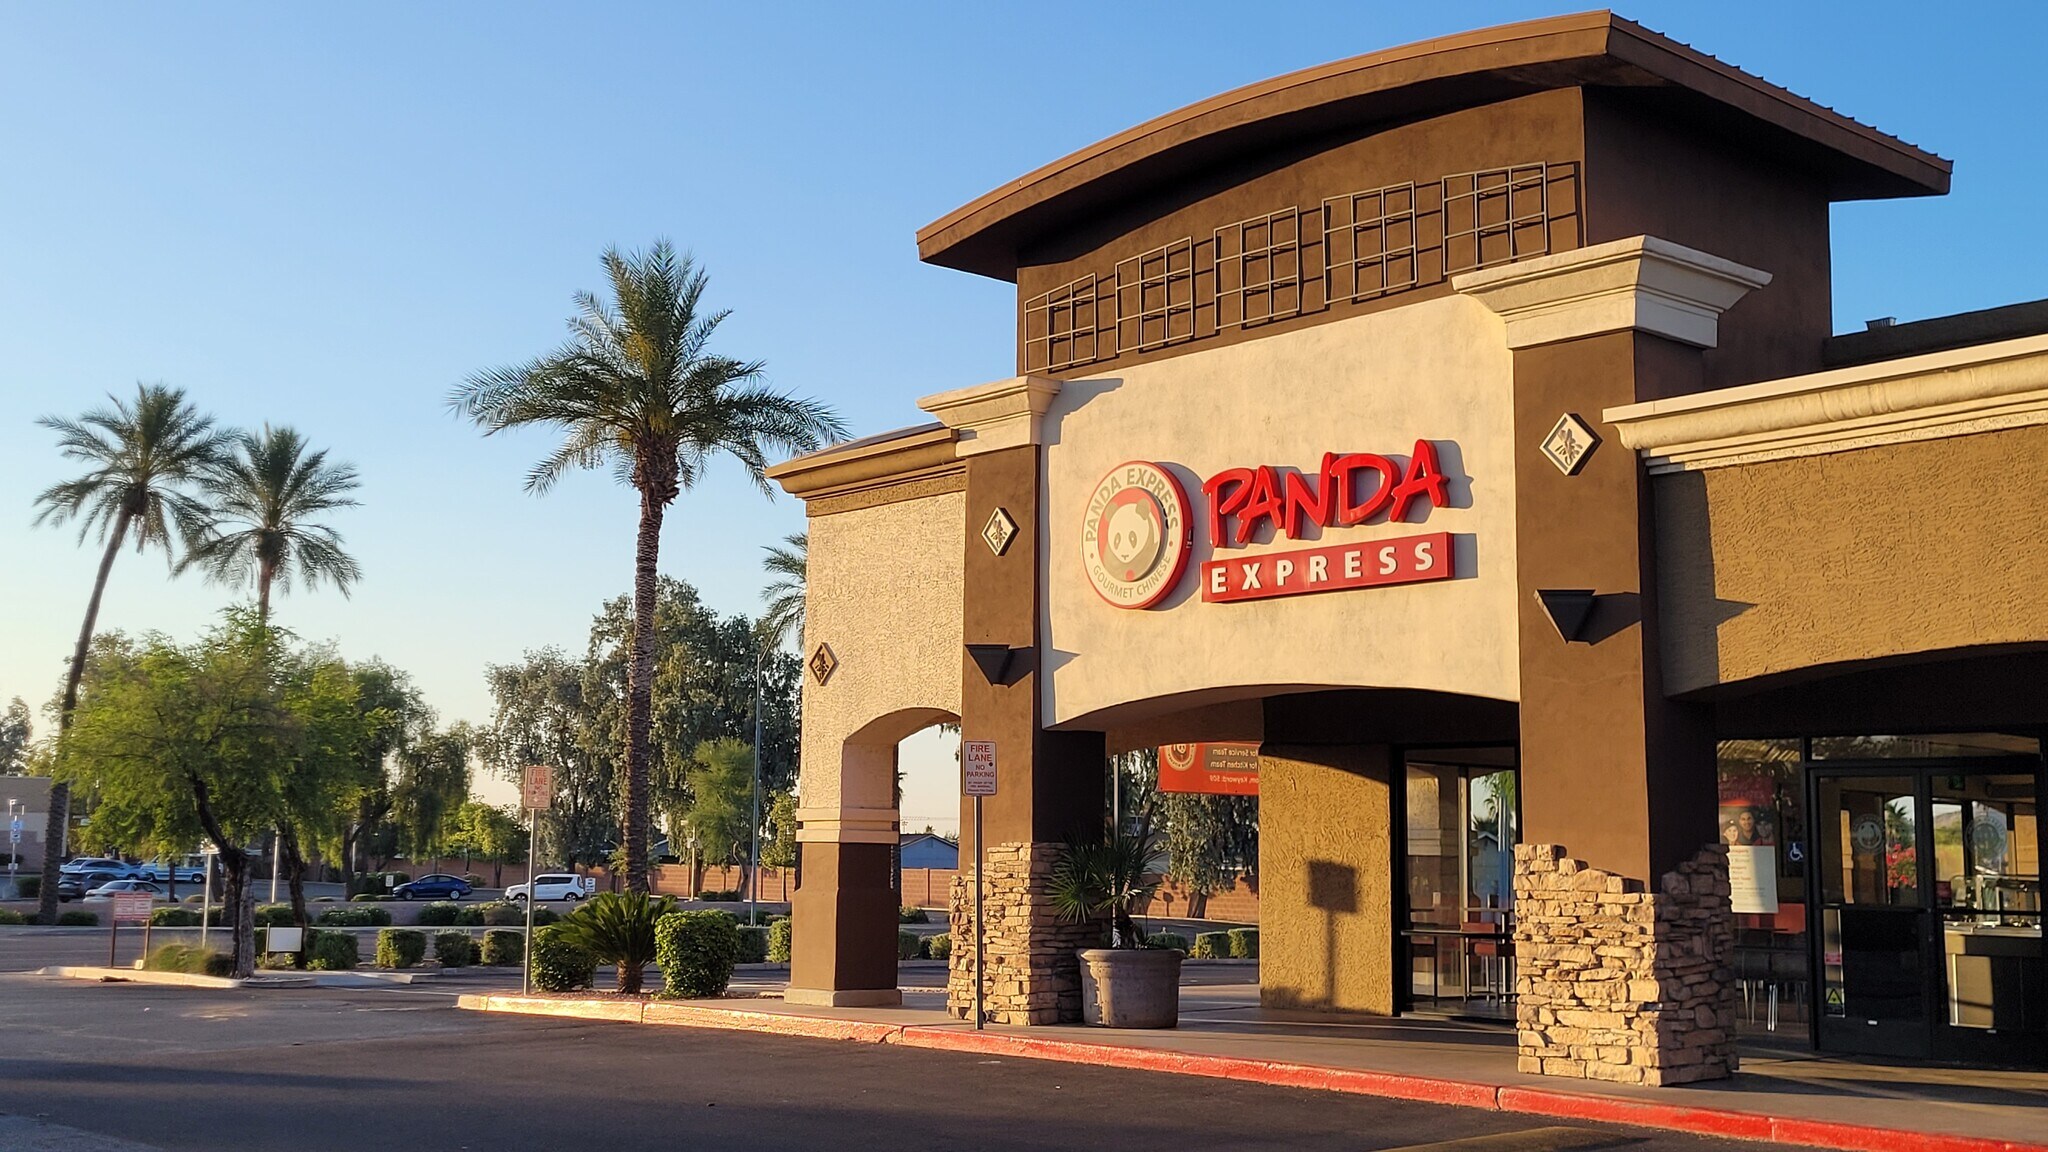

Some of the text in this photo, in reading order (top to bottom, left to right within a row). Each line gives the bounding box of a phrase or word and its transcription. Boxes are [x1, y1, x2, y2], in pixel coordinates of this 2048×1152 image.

[1085, 467, 1179, 542] PANDA EXPRESS
[1201, 439, 1449, 548] PANDA
[1093, 556, 1171, 599] GOURMET CHINESE
[1211, 542, 1434, 593] EXPRESS
[531, 769, 546, 777] FIRE
[968, 754, 992, 762] LANE
[530, 777, 547, 785] LANE
